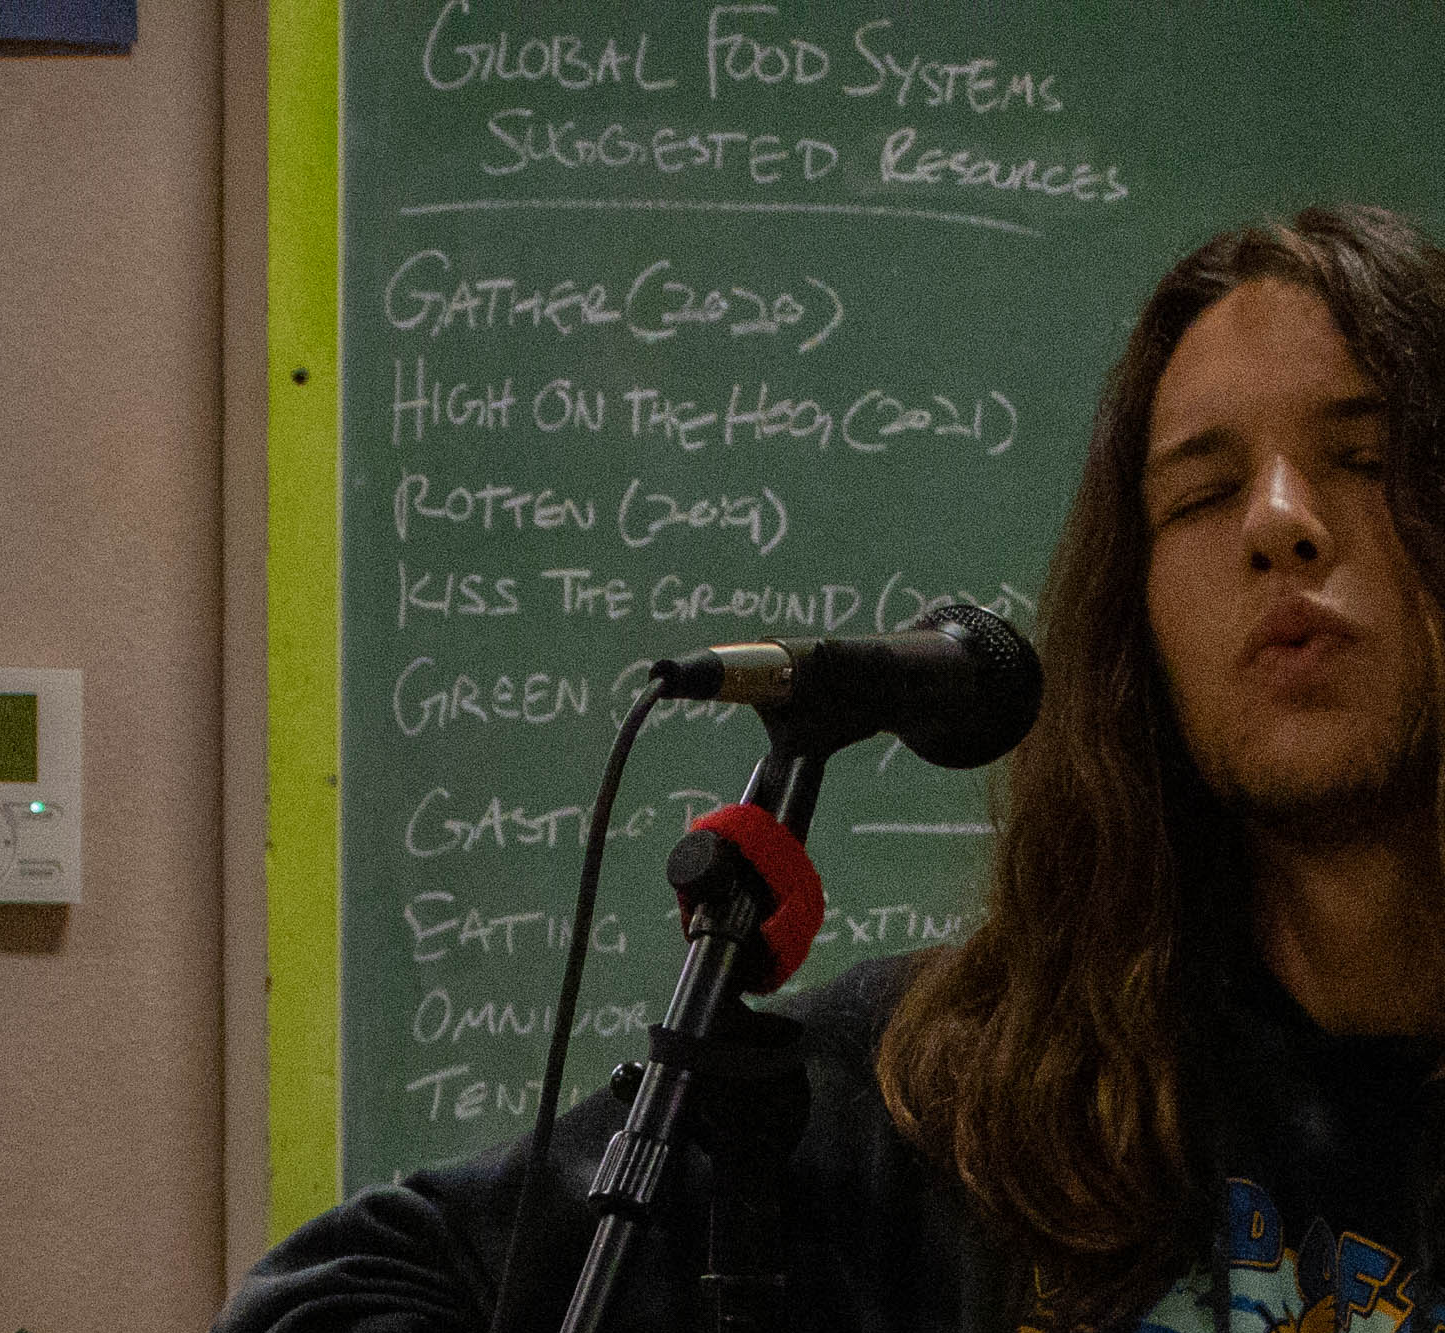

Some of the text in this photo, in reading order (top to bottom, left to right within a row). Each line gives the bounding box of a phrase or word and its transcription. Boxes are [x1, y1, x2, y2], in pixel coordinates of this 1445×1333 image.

[422, 0, 1064, 113] GLOBAL FOOD SYSTEMS
[482, 106, 839, 184] SUGGESTED
[384, 248, 622, 337] GATHER
[392, 354, 517, 448] HIGH
[532, 377, 606, 433] ON
[622, 384, 718, 451] THE
[394, 466, 596, 544] ROTTEN
[397, 559, 520, 630] KISS
[540, 566, 635, 621] THE
[650, 573, 861, 632] GROUND
[392, 655, 589, 737] GREEN
